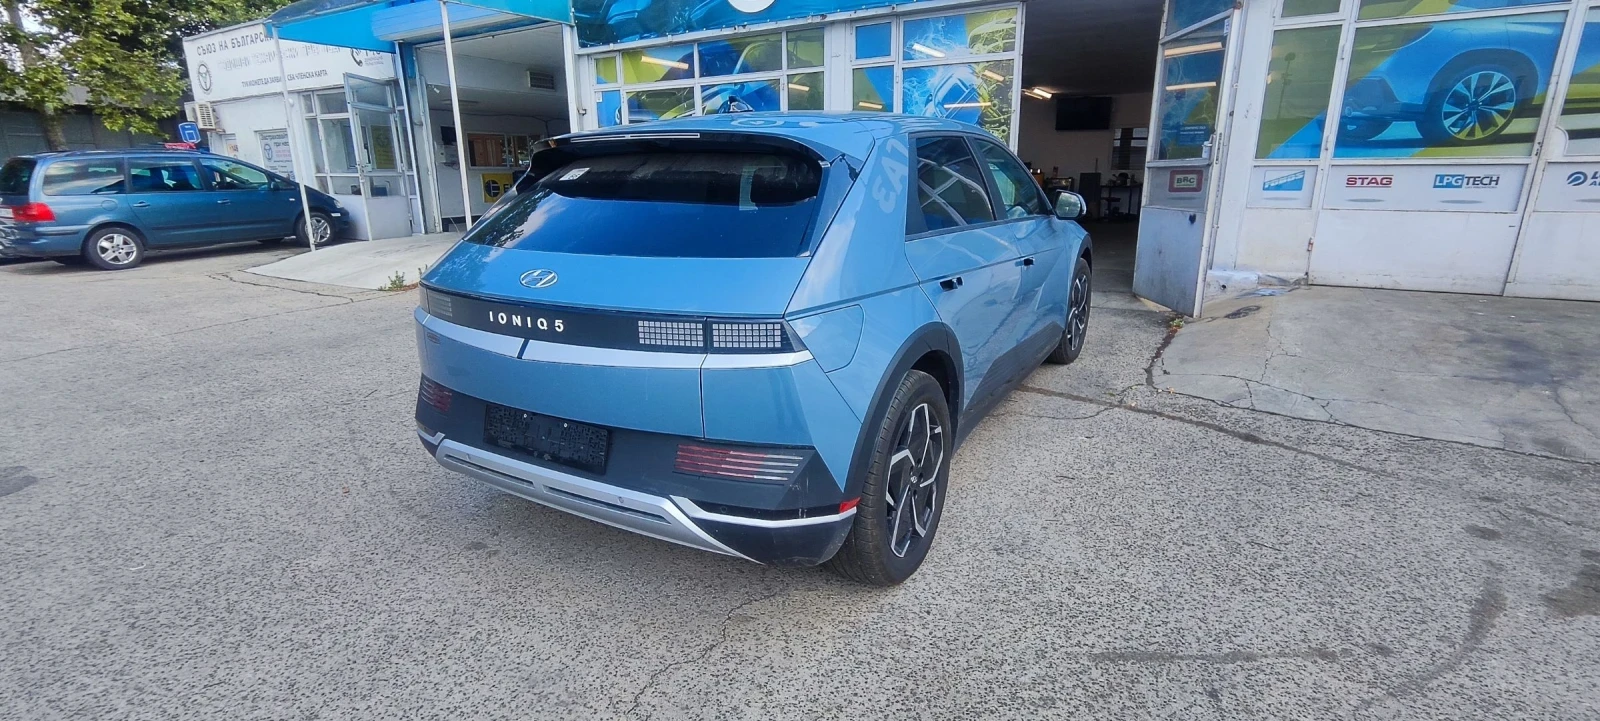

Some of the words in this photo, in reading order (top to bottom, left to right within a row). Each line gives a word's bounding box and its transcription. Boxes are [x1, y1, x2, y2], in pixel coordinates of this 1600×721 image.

[196, 43, 216, 56] СЪЮЗ
[218, 39, 229, 51] НА
[231, 32, 273, 49] БЪЛГАРС
[1176, 175, 1196, 184] BRC
[1346, 176, 1393, 186] STAG
[489, 311, 548, 331] IONIQ
[554, 319, 564, 333] 5
